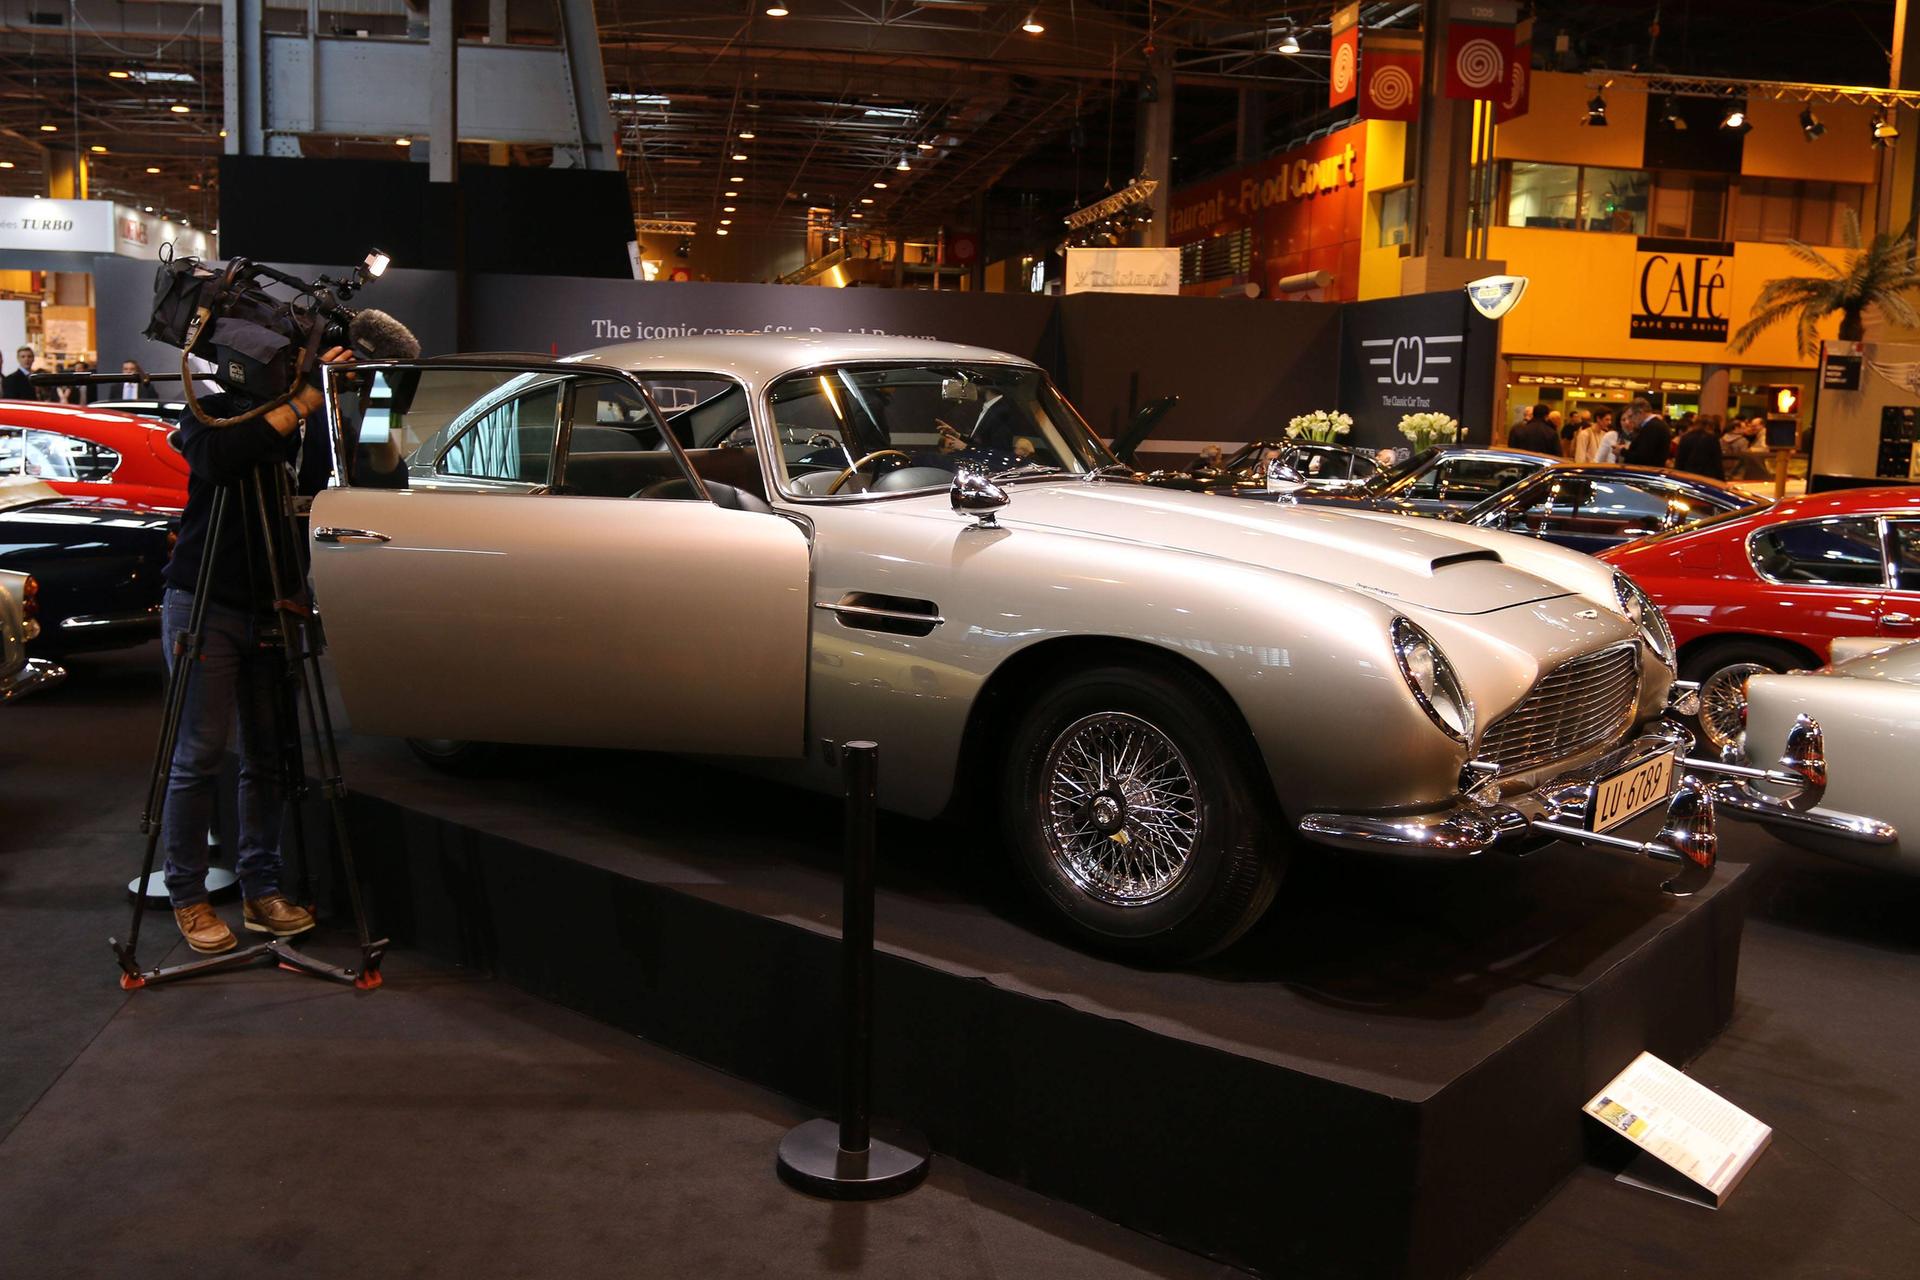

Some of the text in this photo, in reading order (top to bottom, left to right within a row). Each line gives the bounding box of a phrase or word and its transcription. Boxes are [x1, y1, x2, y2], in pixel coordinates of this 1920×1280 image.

[1240, 163, 1288, 215] Food
[1291, 143, 1356, 198] Court
[22, 218, 73, 232] TURBO
[591, 319, 631, 339] The
[637, 321, 697, 340] iconic
[1670, 322, 1685, 330] DE
[1691, 322, 1727, 332] SEINE
[1382, 395, 1392, 406] The
